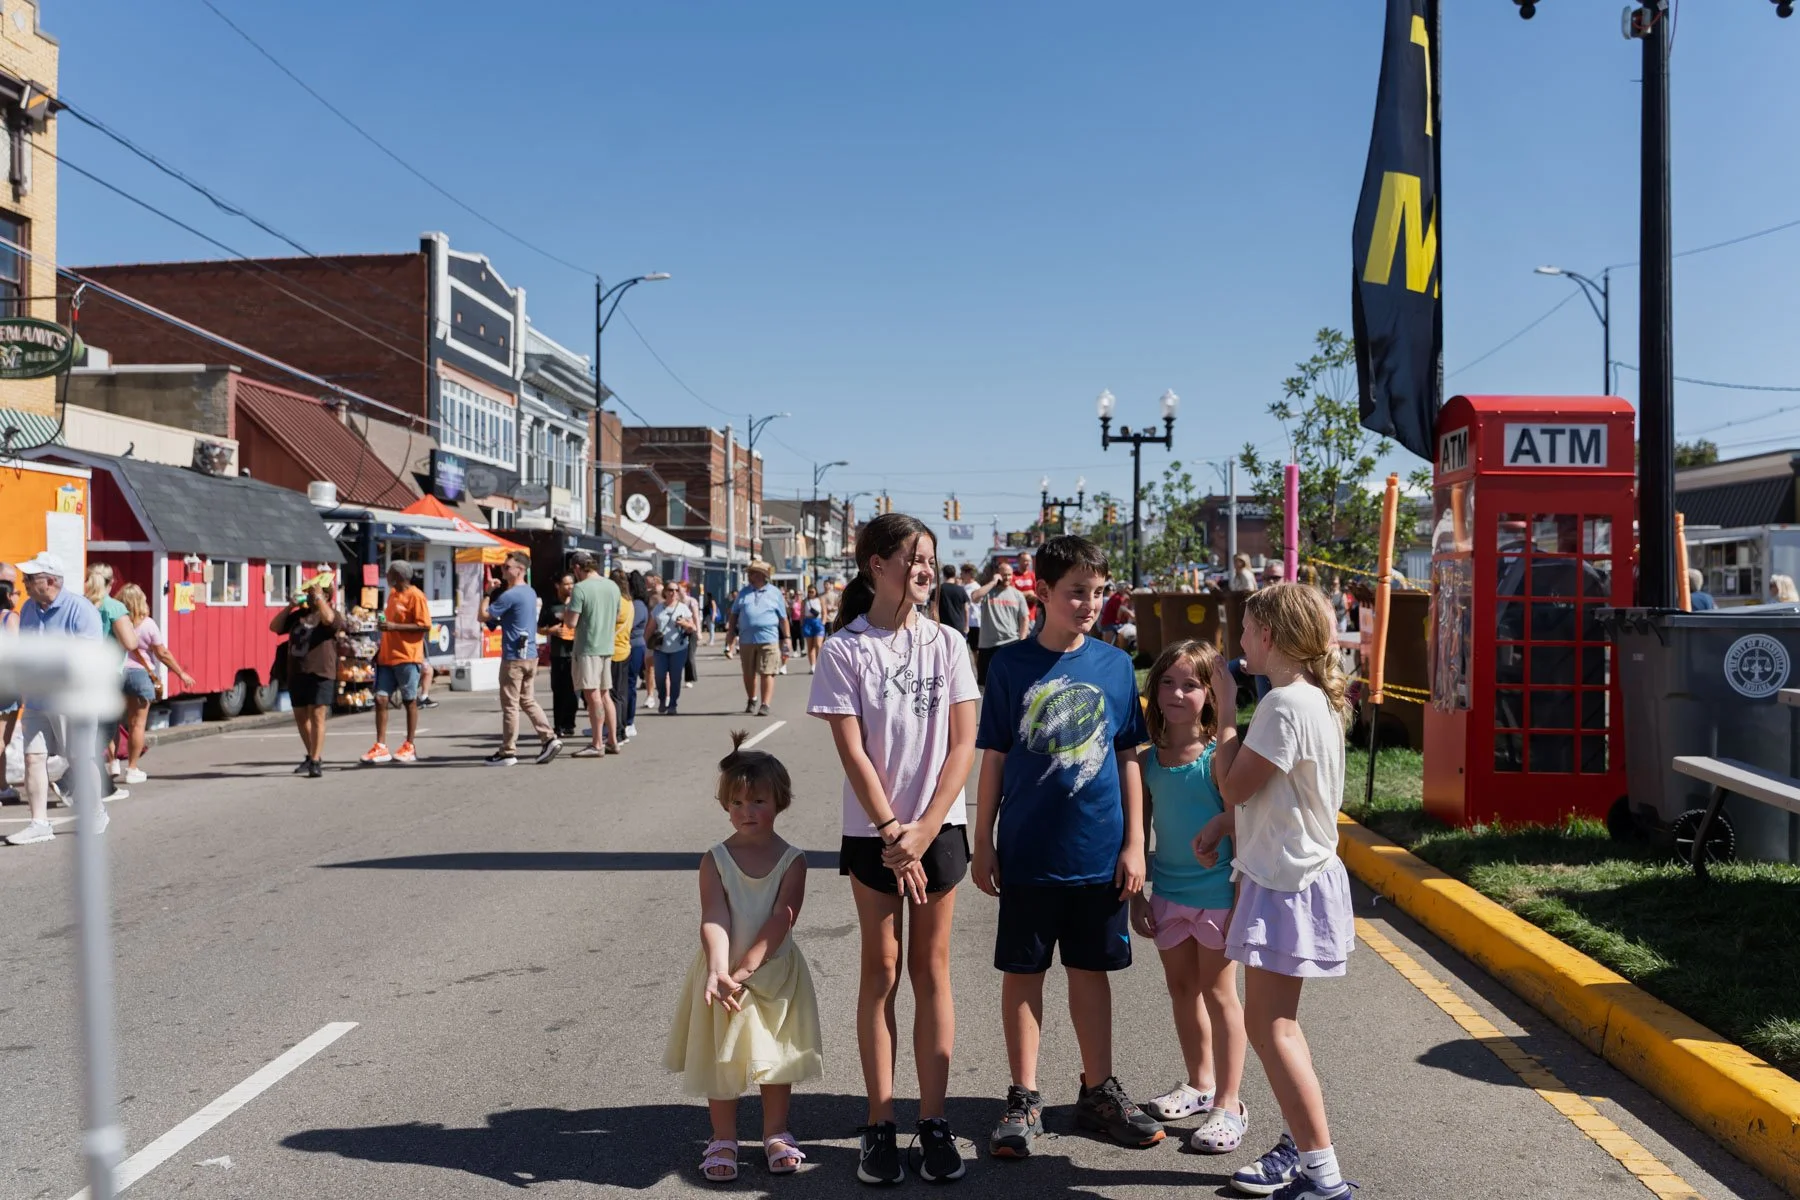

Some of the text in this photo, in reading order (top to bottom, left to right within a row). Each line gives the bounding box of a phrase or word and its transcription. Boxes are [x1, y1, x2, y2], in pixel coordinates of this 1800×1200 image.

[1441, 431, 1467, 472] ATM
[1510, 428, 1601, 463] ATM
[1742, 682, 1771, 692] INDIANA
